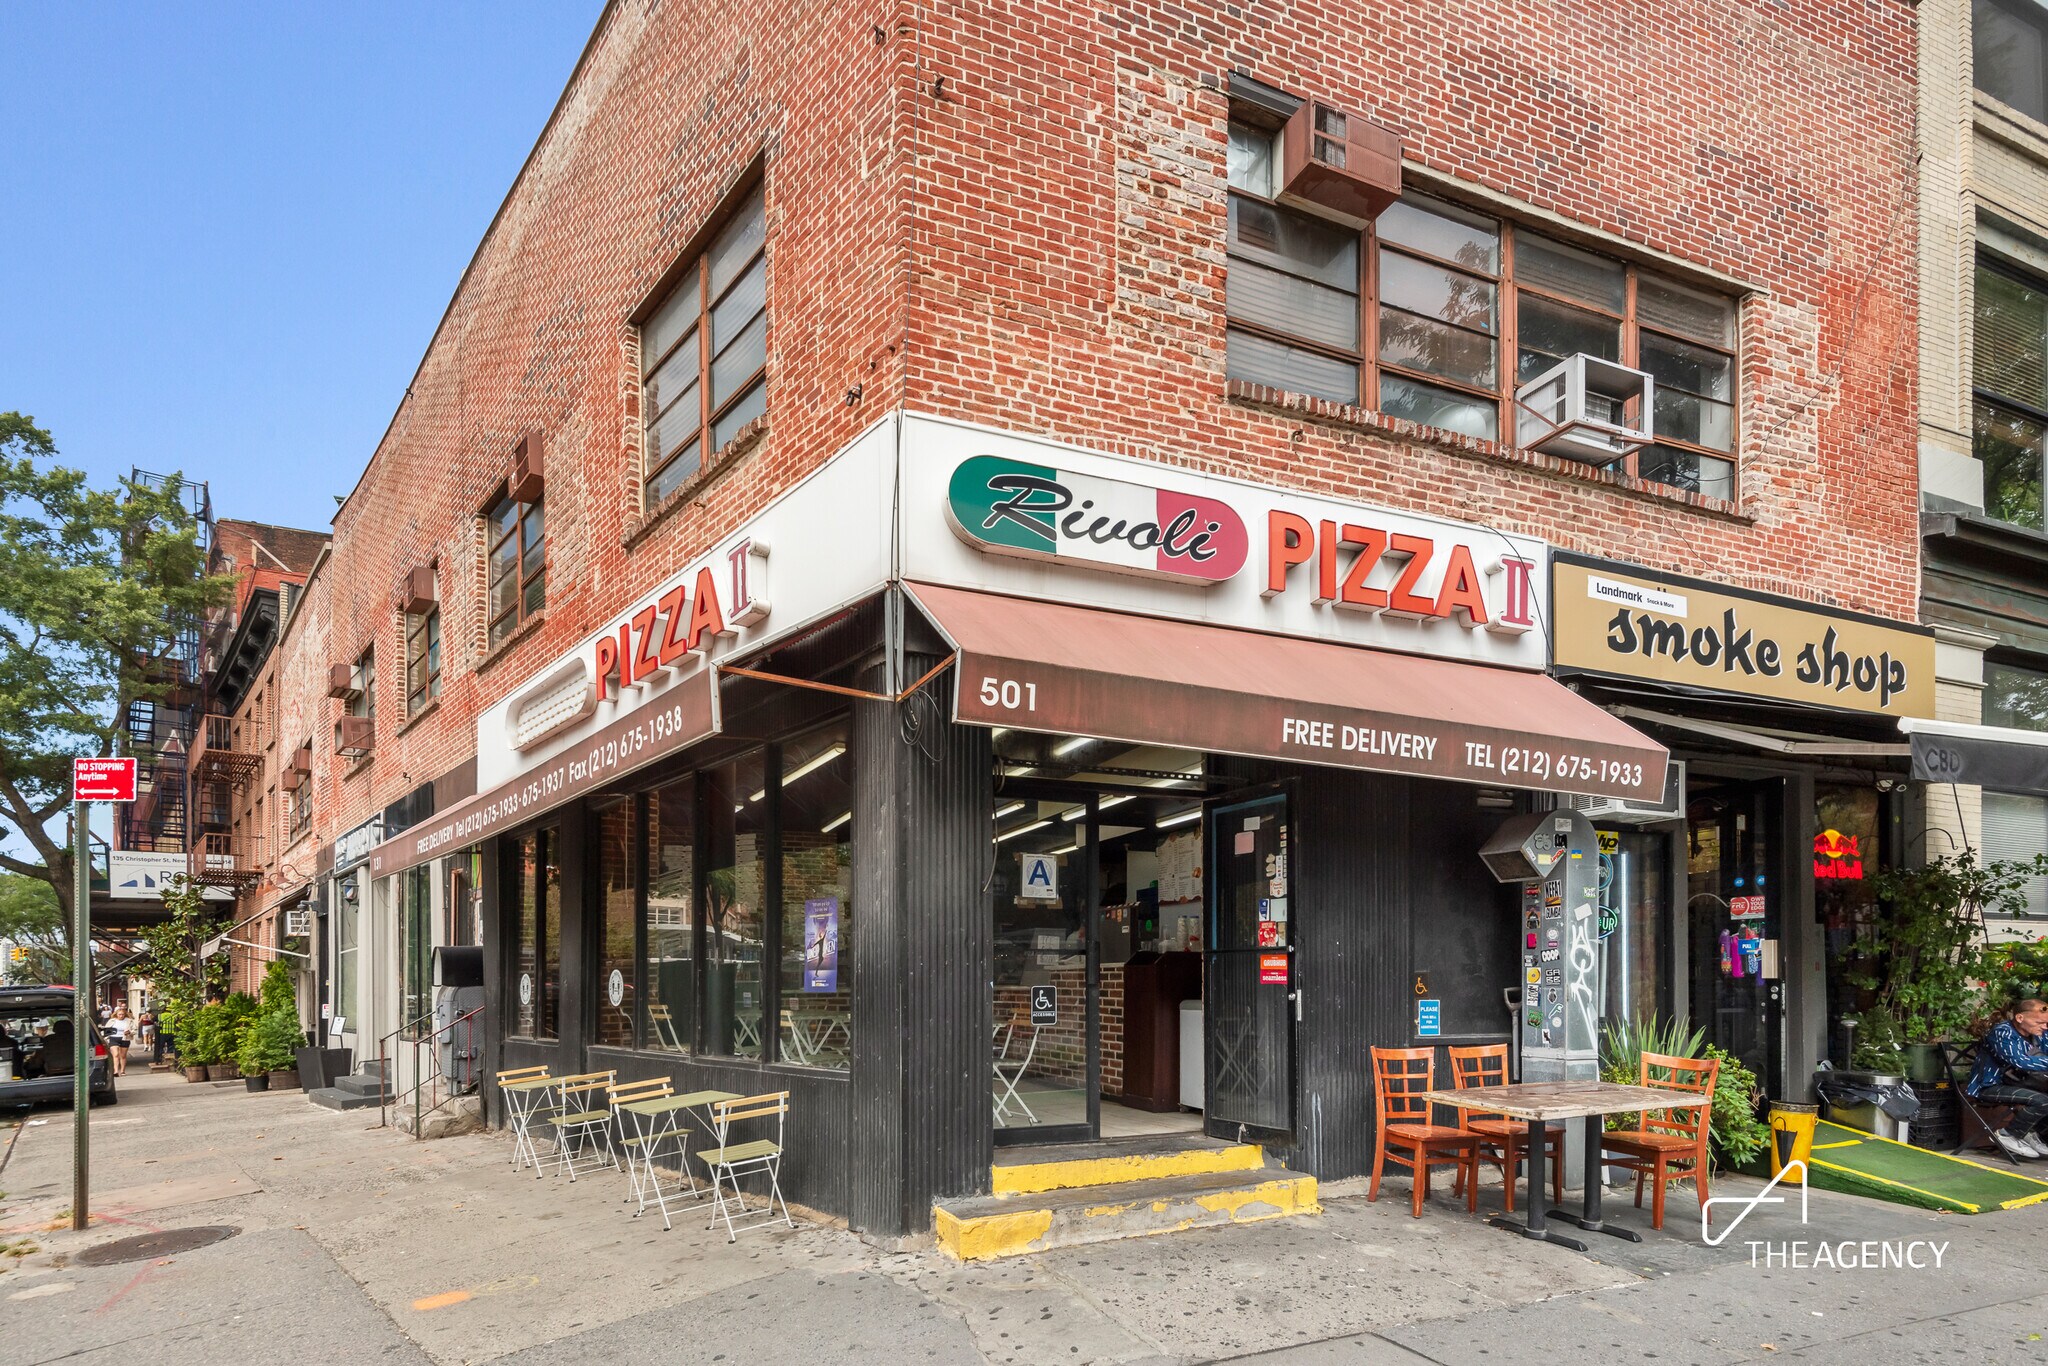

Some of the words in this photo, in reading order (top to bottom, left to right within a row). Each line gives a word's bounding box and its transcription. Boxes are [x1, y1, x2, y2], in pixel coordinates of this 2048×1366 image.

[982, 474, 1217, 561] Rivoli
[1267, 509, 1489, 625] PIZZA
[1596, 582, 1643, 603] Landmark
[595, 566, 724, 702] PIZZA
[1606, 607, 1783, 678] smoke
[1796, 625, 1907, 708] shop
[979, 676, 1038, 712] 501
[78, 762, 89, 771] NO
[89, 762, 125, 771] STOPPING
[1282, 718, 1335, 748] FREE
[1341, 725, 1438, 761] DELIVERY
[1465, 742, 1495, 768] TEL
[1501, 747, 1551, 781] (212)
[1556, 754, 1643, 787] 675-1933
[1925, 747, 1960, 773] CBD
[78, 772, 108, 782] Anytime
[416, 836, 429, 855] FREE
[429, 823, 454, 850] DELIVERY
[455, 820, 465, 838] Tel
[465, 811, 482, 838] (212)
[568, 759, 587, 784] Fax
[588, 740, 618, 779] (212)
[620, 705, 682, 758] 675-1938
[1028, 859, 1051, 886] A
[1836, 859, 1863, 880] Bull
